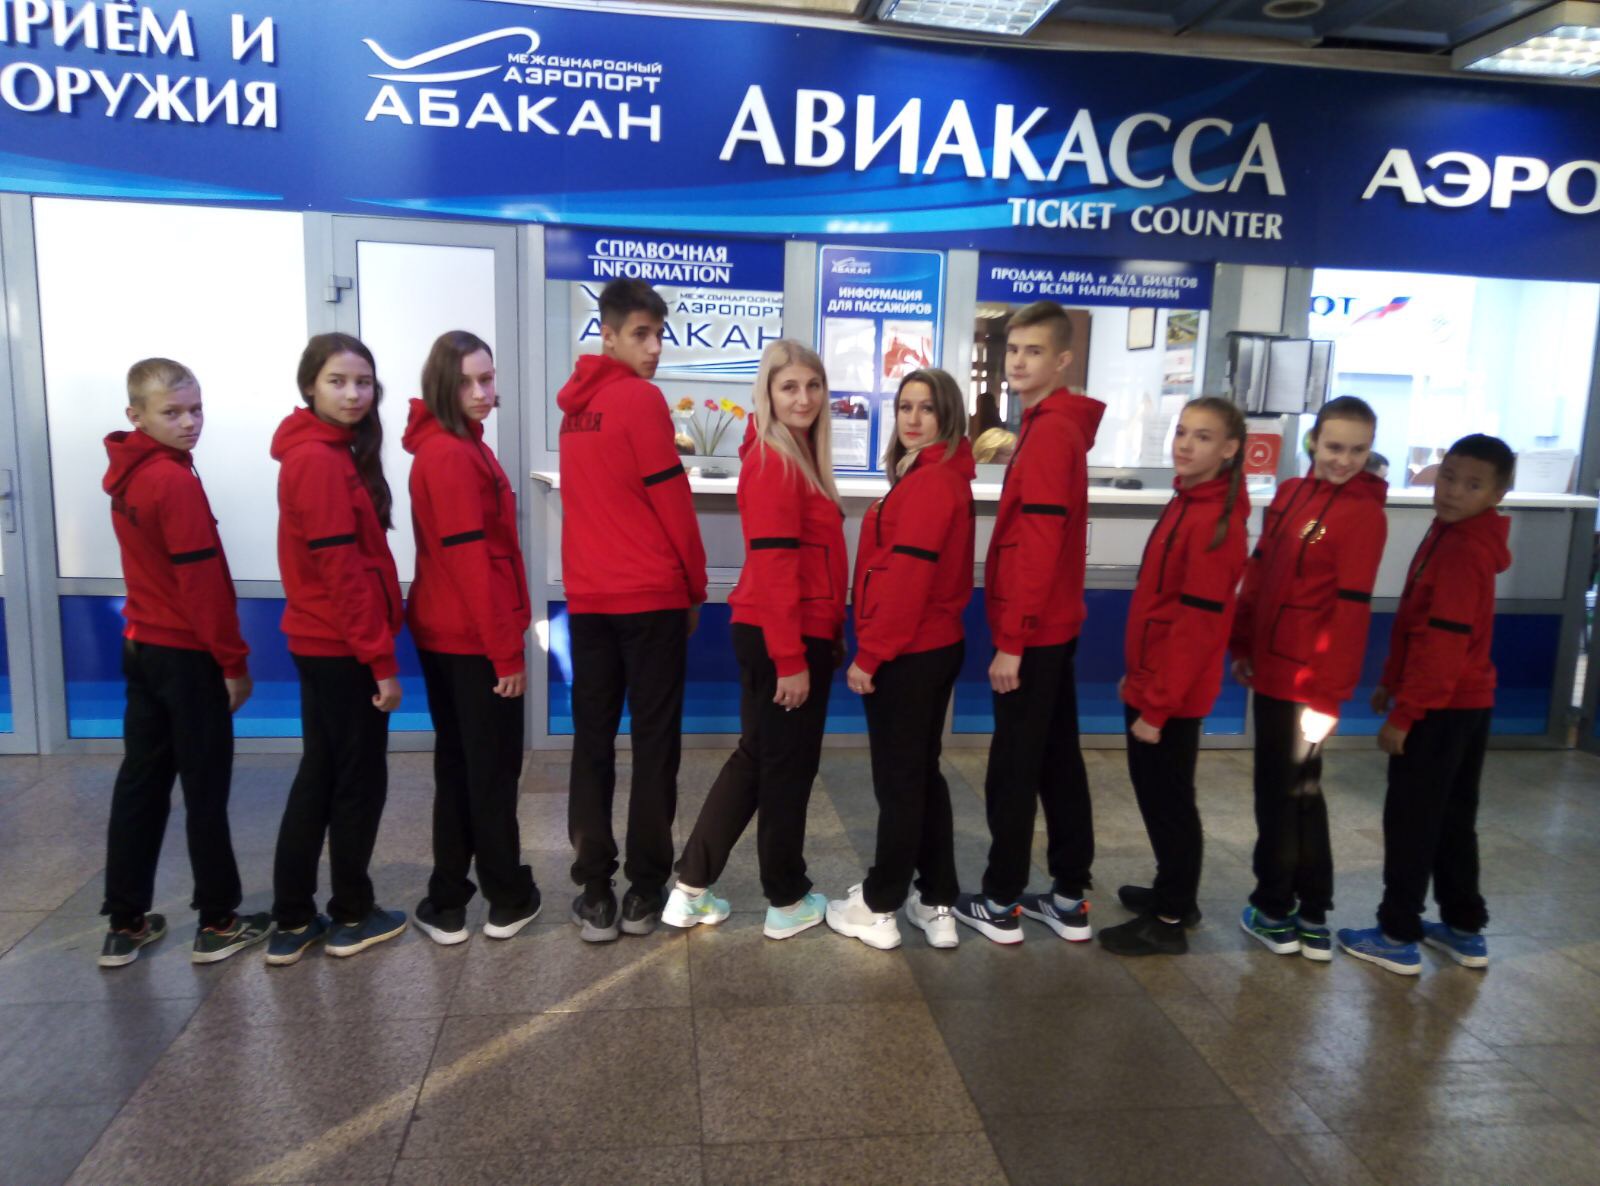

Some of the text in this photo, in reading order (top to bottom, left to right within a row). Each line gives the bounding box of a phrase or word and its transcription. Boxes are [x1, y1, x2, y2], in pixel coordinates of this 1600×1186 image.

[231, 14, 275, 63] И
[507, 53, 663, 75] МЕЖДУНАРОДНЫЙ
[503, 65, 661, 93] АЭРОПОРТ
[0, 61, 278, 128] ОРУЖИЯ
[364, 84, 661, 142] АБАКАН
[718, 84, 1287, 197] АВИАКАССА
[1361, 148, 1600, 215] АЭРО
[1007, 197, 1283, 240] TICKET COUNTER
[595, 239, 728, 263] СПРАВОЧНАЯ
[593, 259, 730, 284] INFORMATION
[991, 267, 1054, 282] ПРОДАЖА
[1058, 269, 1094, 283] АВИА
[1112, 273, 1137, 286] Ж/Д
[1143, 275, 1199, 289] БИЛЕТОВ
[838, 286, 923, 302] ИНФОРМАЦИЯ
[1012, 281, 1180, 300] ПО ВСЕМ НАПРАВЛЕНИЯМ
[676, 302, 784, 319] АЭРОПОРТ
[827, 299, 932, 315] ДЛЯ ПАССАЖИРОВ
